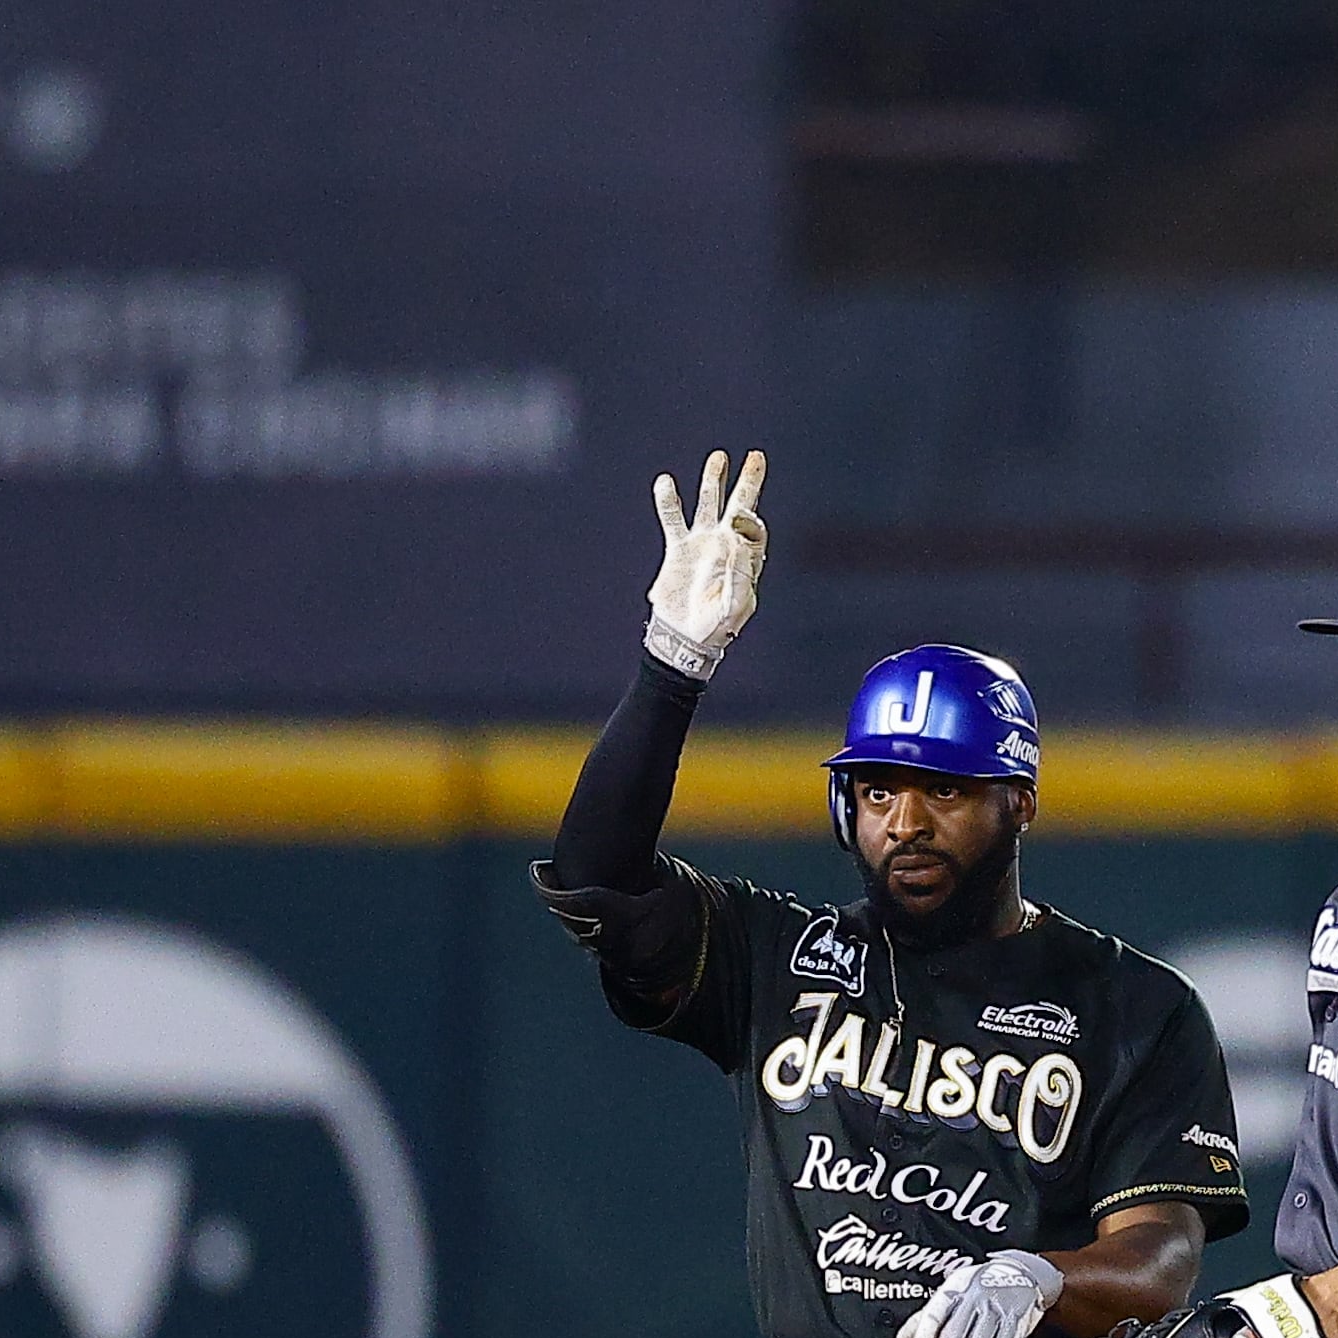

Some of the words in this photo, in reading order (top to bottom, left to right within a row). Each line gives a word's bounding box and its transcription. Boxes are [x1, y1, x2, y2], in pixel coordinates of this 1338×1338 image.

[888, 670, 934, 735] J
[981, 1005, 1079, 1037] Electrolit
[762, 992, 1083, 1165] JALISCO
[793, 1134, 888, 1201] Red
[891, 1164, 1010, 1233] Cola
